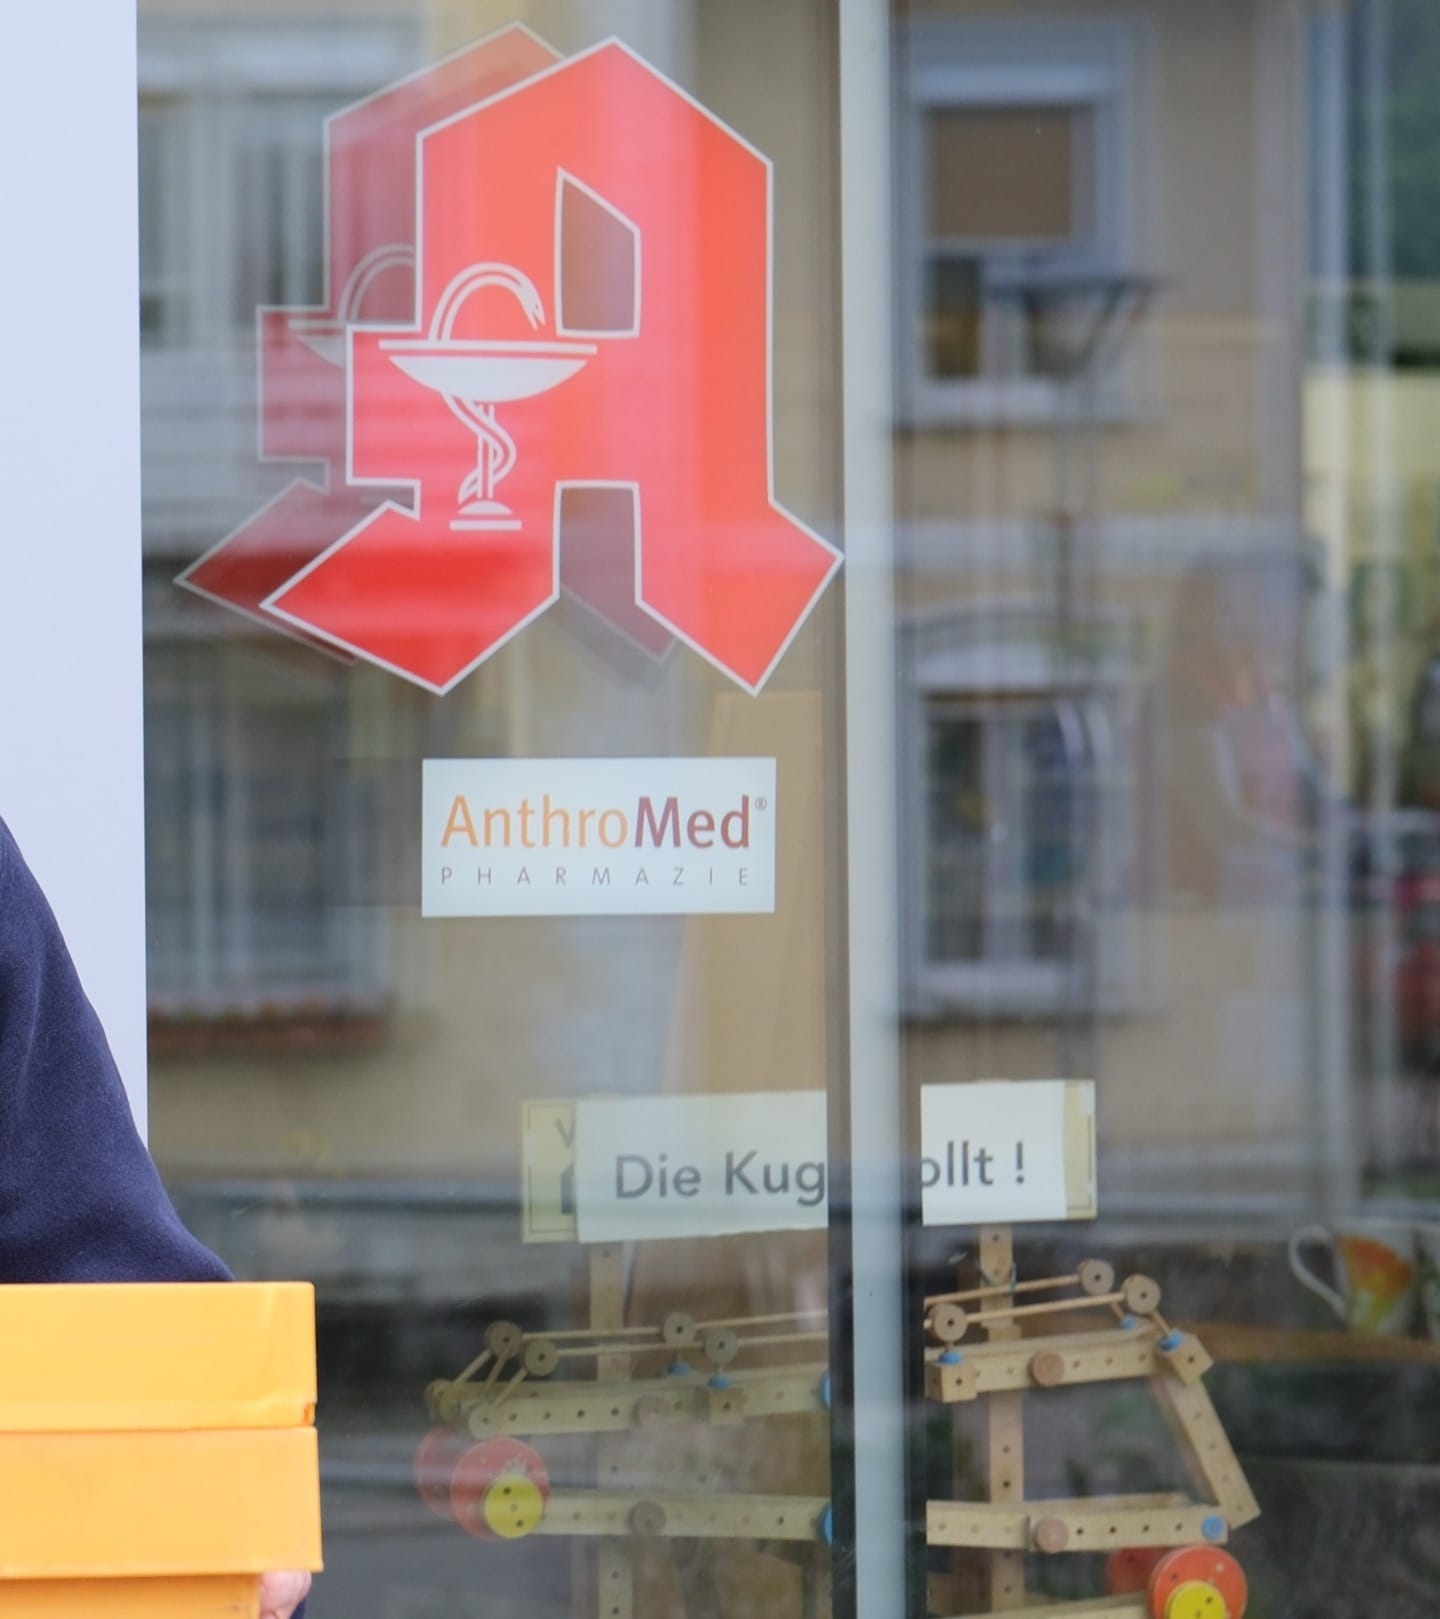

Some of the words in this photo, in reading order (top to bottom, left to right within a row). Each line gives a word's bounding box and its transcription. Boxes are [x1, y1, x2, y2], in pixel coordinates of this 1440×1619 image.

[441, 866, 749, 886] PHARMAZIE
[615, 1154, 702, 1199] Die
[724, 1150, 826, 1207] Kug
[922, 1140, 994, 1187] ollt
[1016, 1141, 1024, 1185] !
